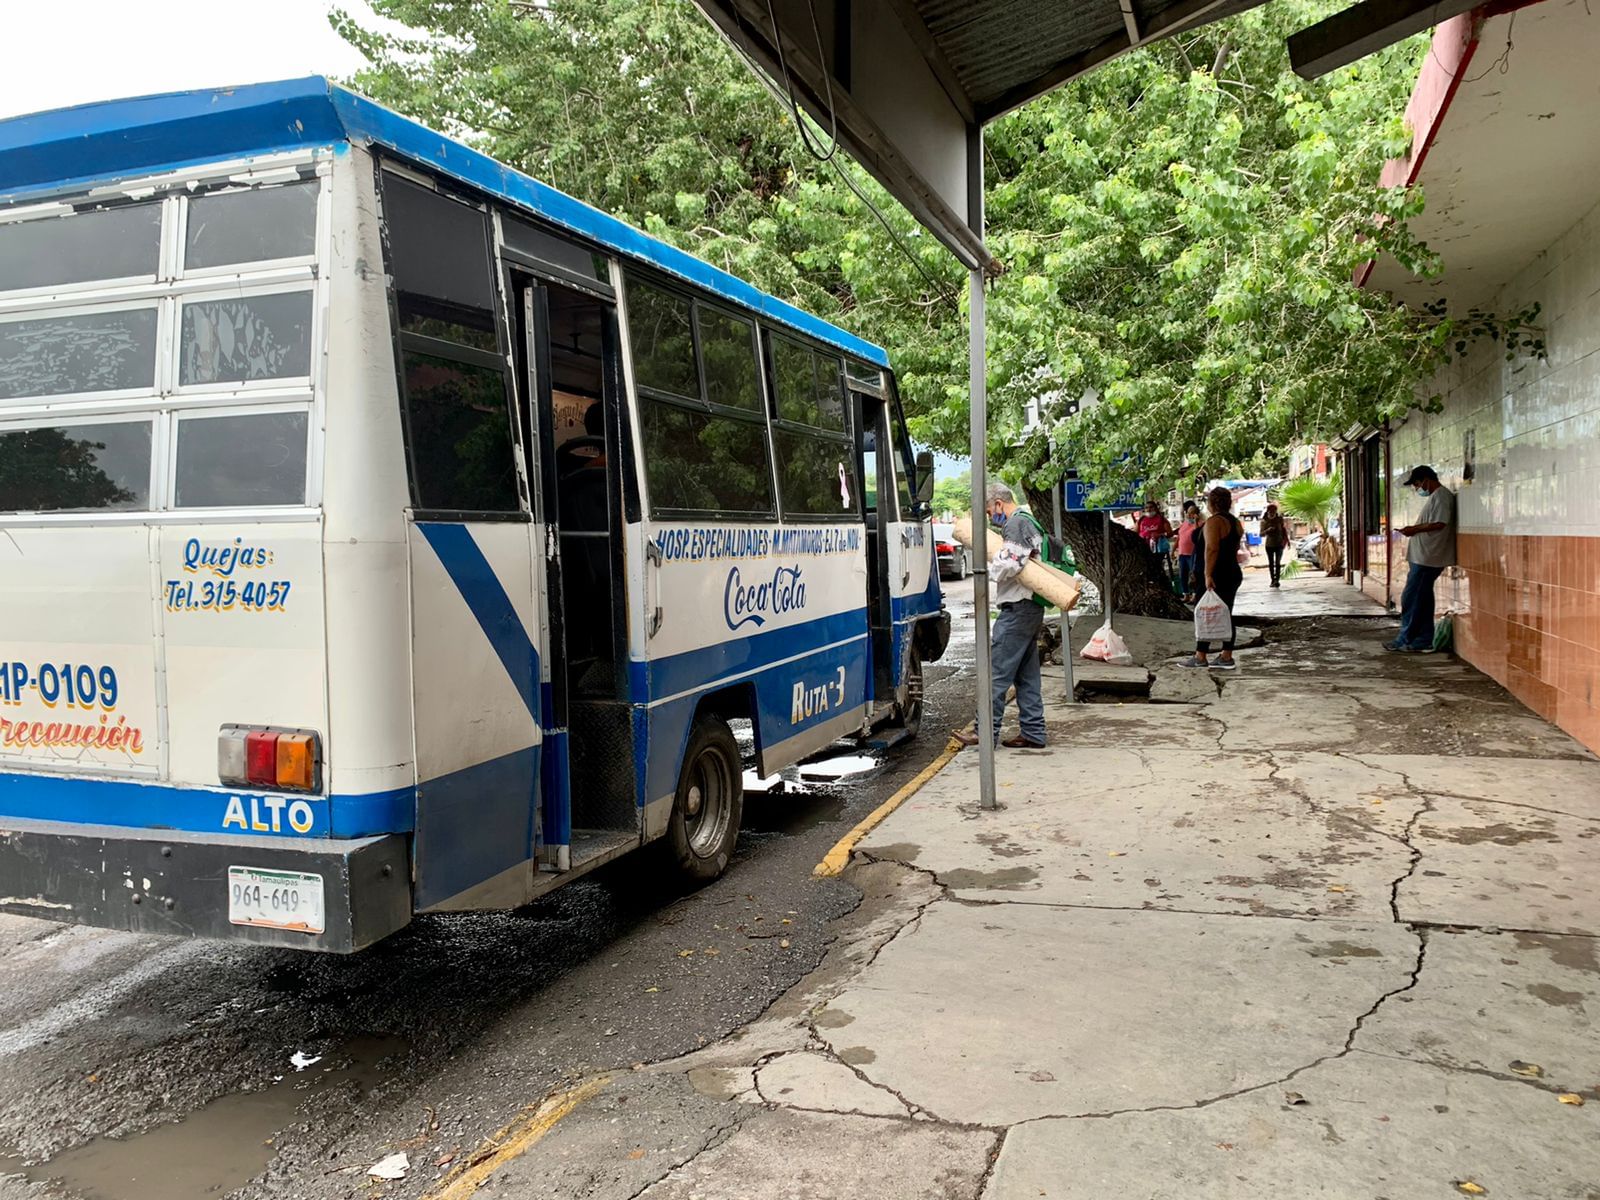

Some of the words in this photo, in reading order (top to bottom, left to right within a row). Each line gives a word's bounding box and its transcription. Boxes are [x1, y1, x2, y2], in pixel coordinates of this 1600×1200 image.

[1076, 484, 1091, 495] DE
[183, 536, 275, 579] Quejas:
[656, 528, 689, 560] HOSP.
[691, 528, 769, 560] ESPECIALIDADES
[0, 661, 119, 711] 1P-0109
[0, 713, 144, 754] recaución
[222, 796, 314, 834] ALTO
[259, 874, 299, 887] Tamaulipas
